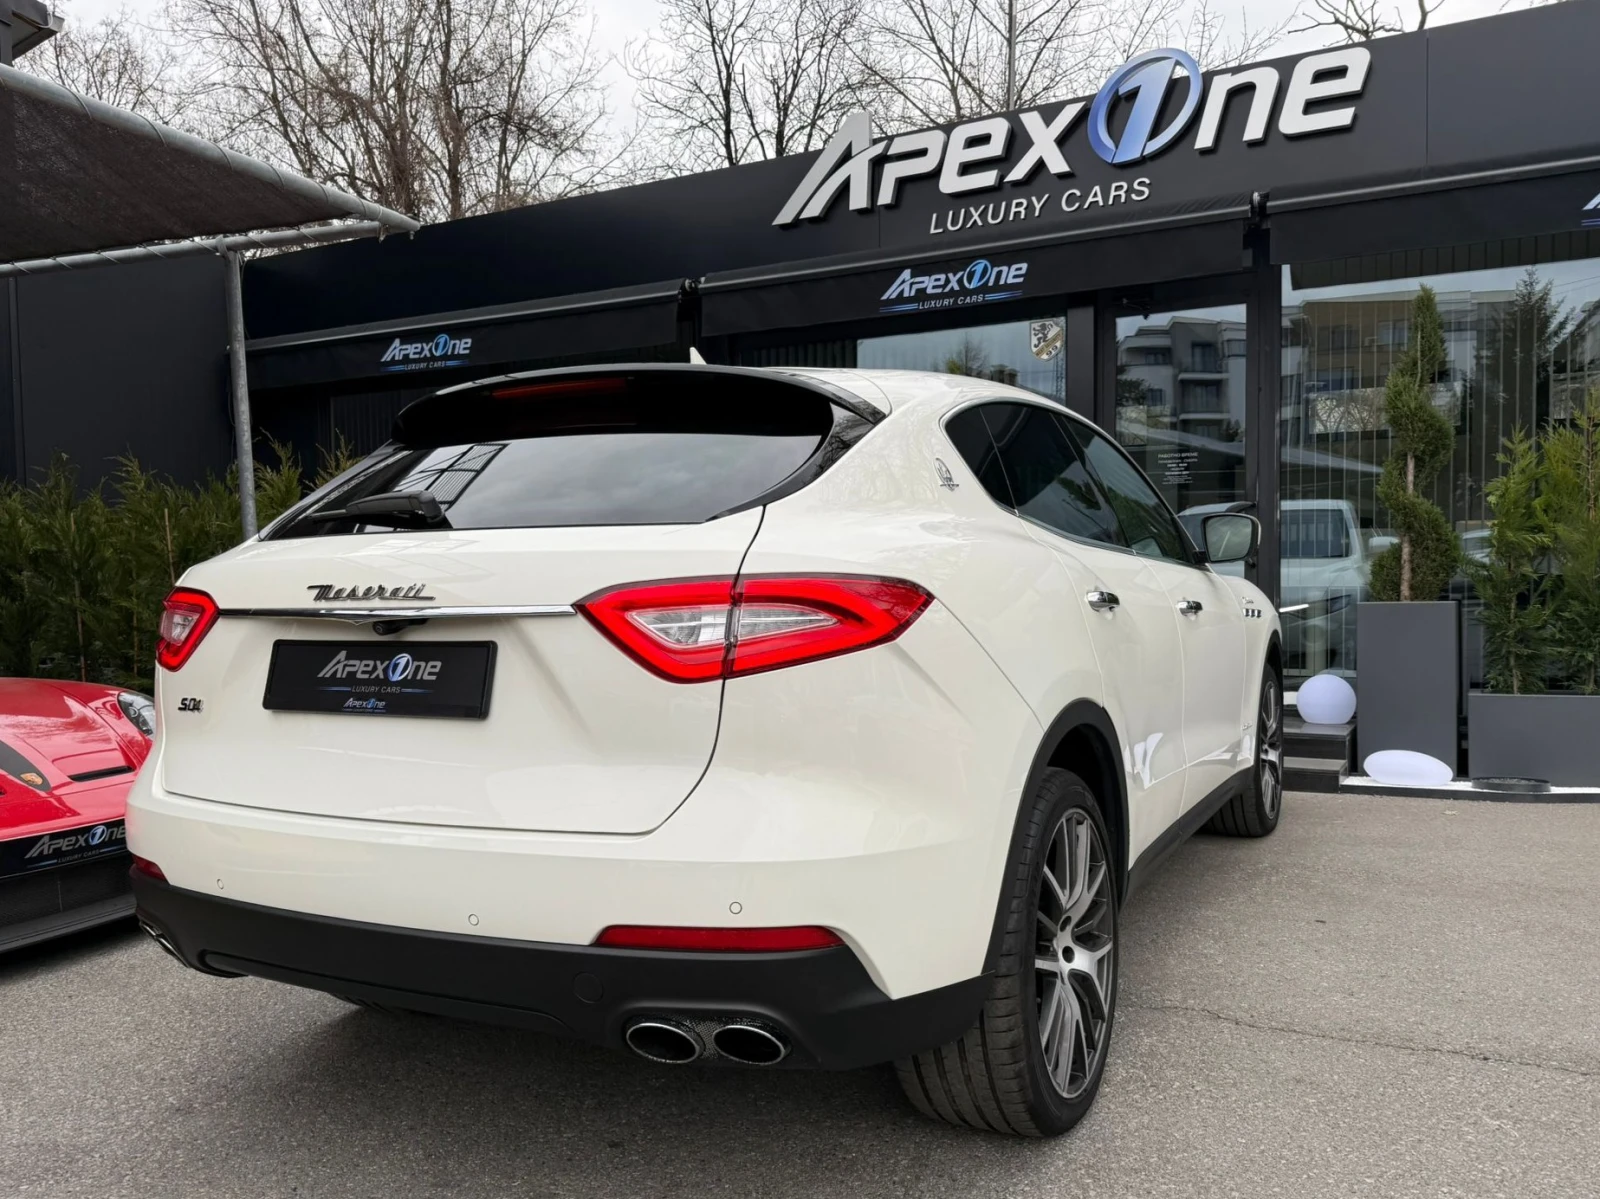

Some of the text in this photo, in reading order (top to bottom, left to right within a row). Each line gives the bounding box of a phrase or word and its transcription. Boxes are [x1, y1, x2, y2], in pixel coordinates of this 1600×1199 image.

[930, 177, 1151, 234] LUXURY CARS
[919, 294, 984, 310] LUXURY CARS
[404, 362, 428, 370] LUXURY
[307, 583, 436, 602] Maserati
[352, 685, 401, 694] LUXURY CARS
[83, 849, 100, 858] CARS
